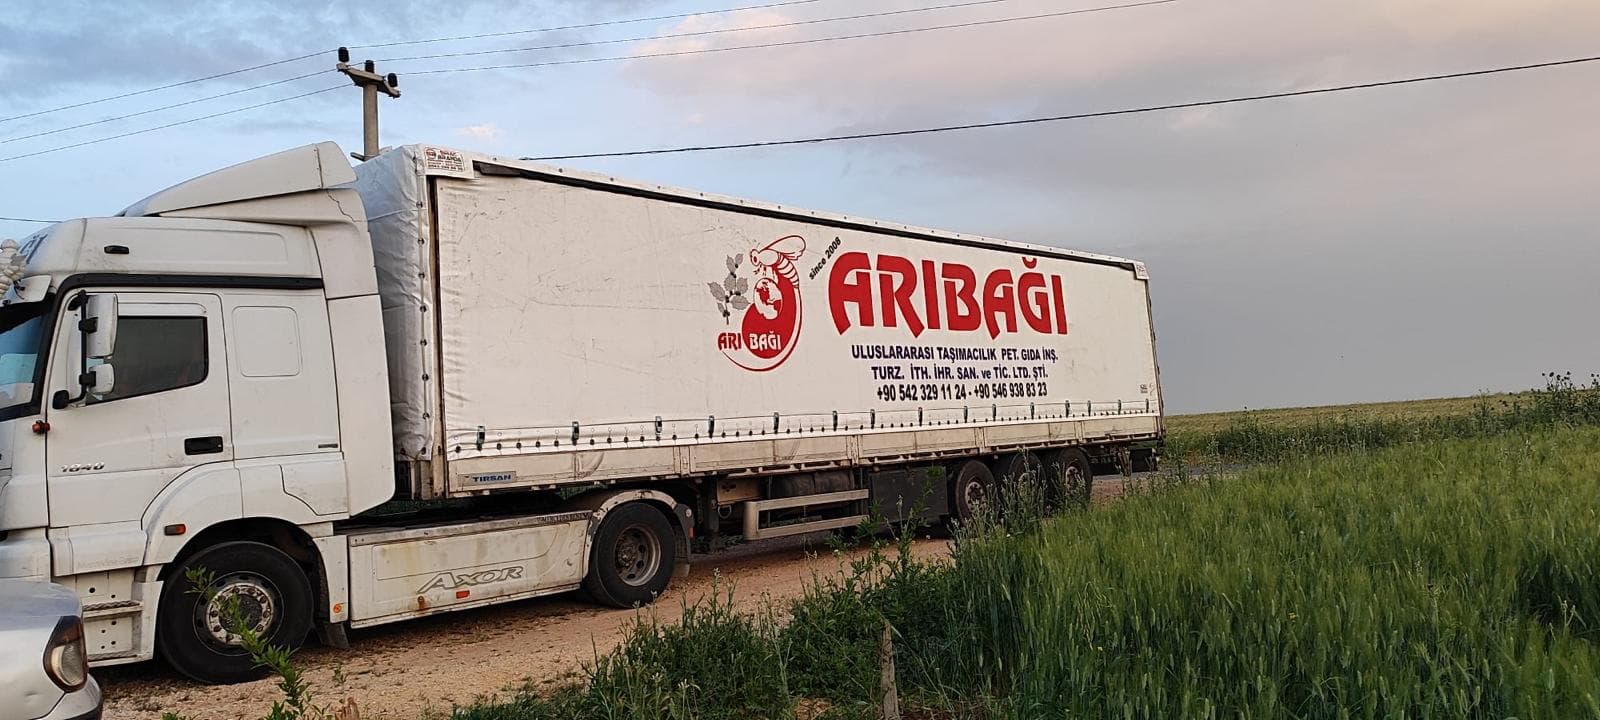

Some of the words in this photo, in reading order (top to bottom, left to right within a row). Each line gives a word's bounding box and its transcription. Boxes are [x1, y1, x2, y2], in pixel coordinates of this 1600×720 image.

[809, 257, 827, 281] since
[824, 236, 842, 260] 2008
[828, 251, 1068, 341] ARIBAĞI
[717, 332, 742, 351] ARI
[749, 330, 782, 351] BAĞI
[852, 344, 935, 360] ULUSLARARASI
[936, 346, 997, 364] TAŞIMACILIK
[1001, 348, 1020, 361] PET.
[1021, 348, 1040, 361] GIDA
[1042, 346, 1059, 364] İNŞ.
[871, 366, 905, 380] TURZ.
[910, 363, 932, 380] İTH.
[934, 363, 955, 380] İHR.
[957, 366, 979, 380] SAN.
[981, 369, 992, 379] ve
[993, 363, 1011, 379] TİC.
[1012, 366, 1031, 379] LTD.
[1033, 363, 1049, 381] ŞTİ.
[877, 384, 896, 401] +90
[899, 384, 918, 401] 542
[920, 384, 938, 401] 329
[941, 383, 952, 400] 11
[954, 384, 966, 400] 24
[974, 383, 990, 399] +90
[992, 382, 1008, 398] 546
[1009, 382, 1025, 398] 938
[1026, 382, 1036, 397] 83
[1037, 381, 1048, 397] 23
[472, 474, 512, 483] TIRSAN
[417, 566, 524, 594] AXOR
